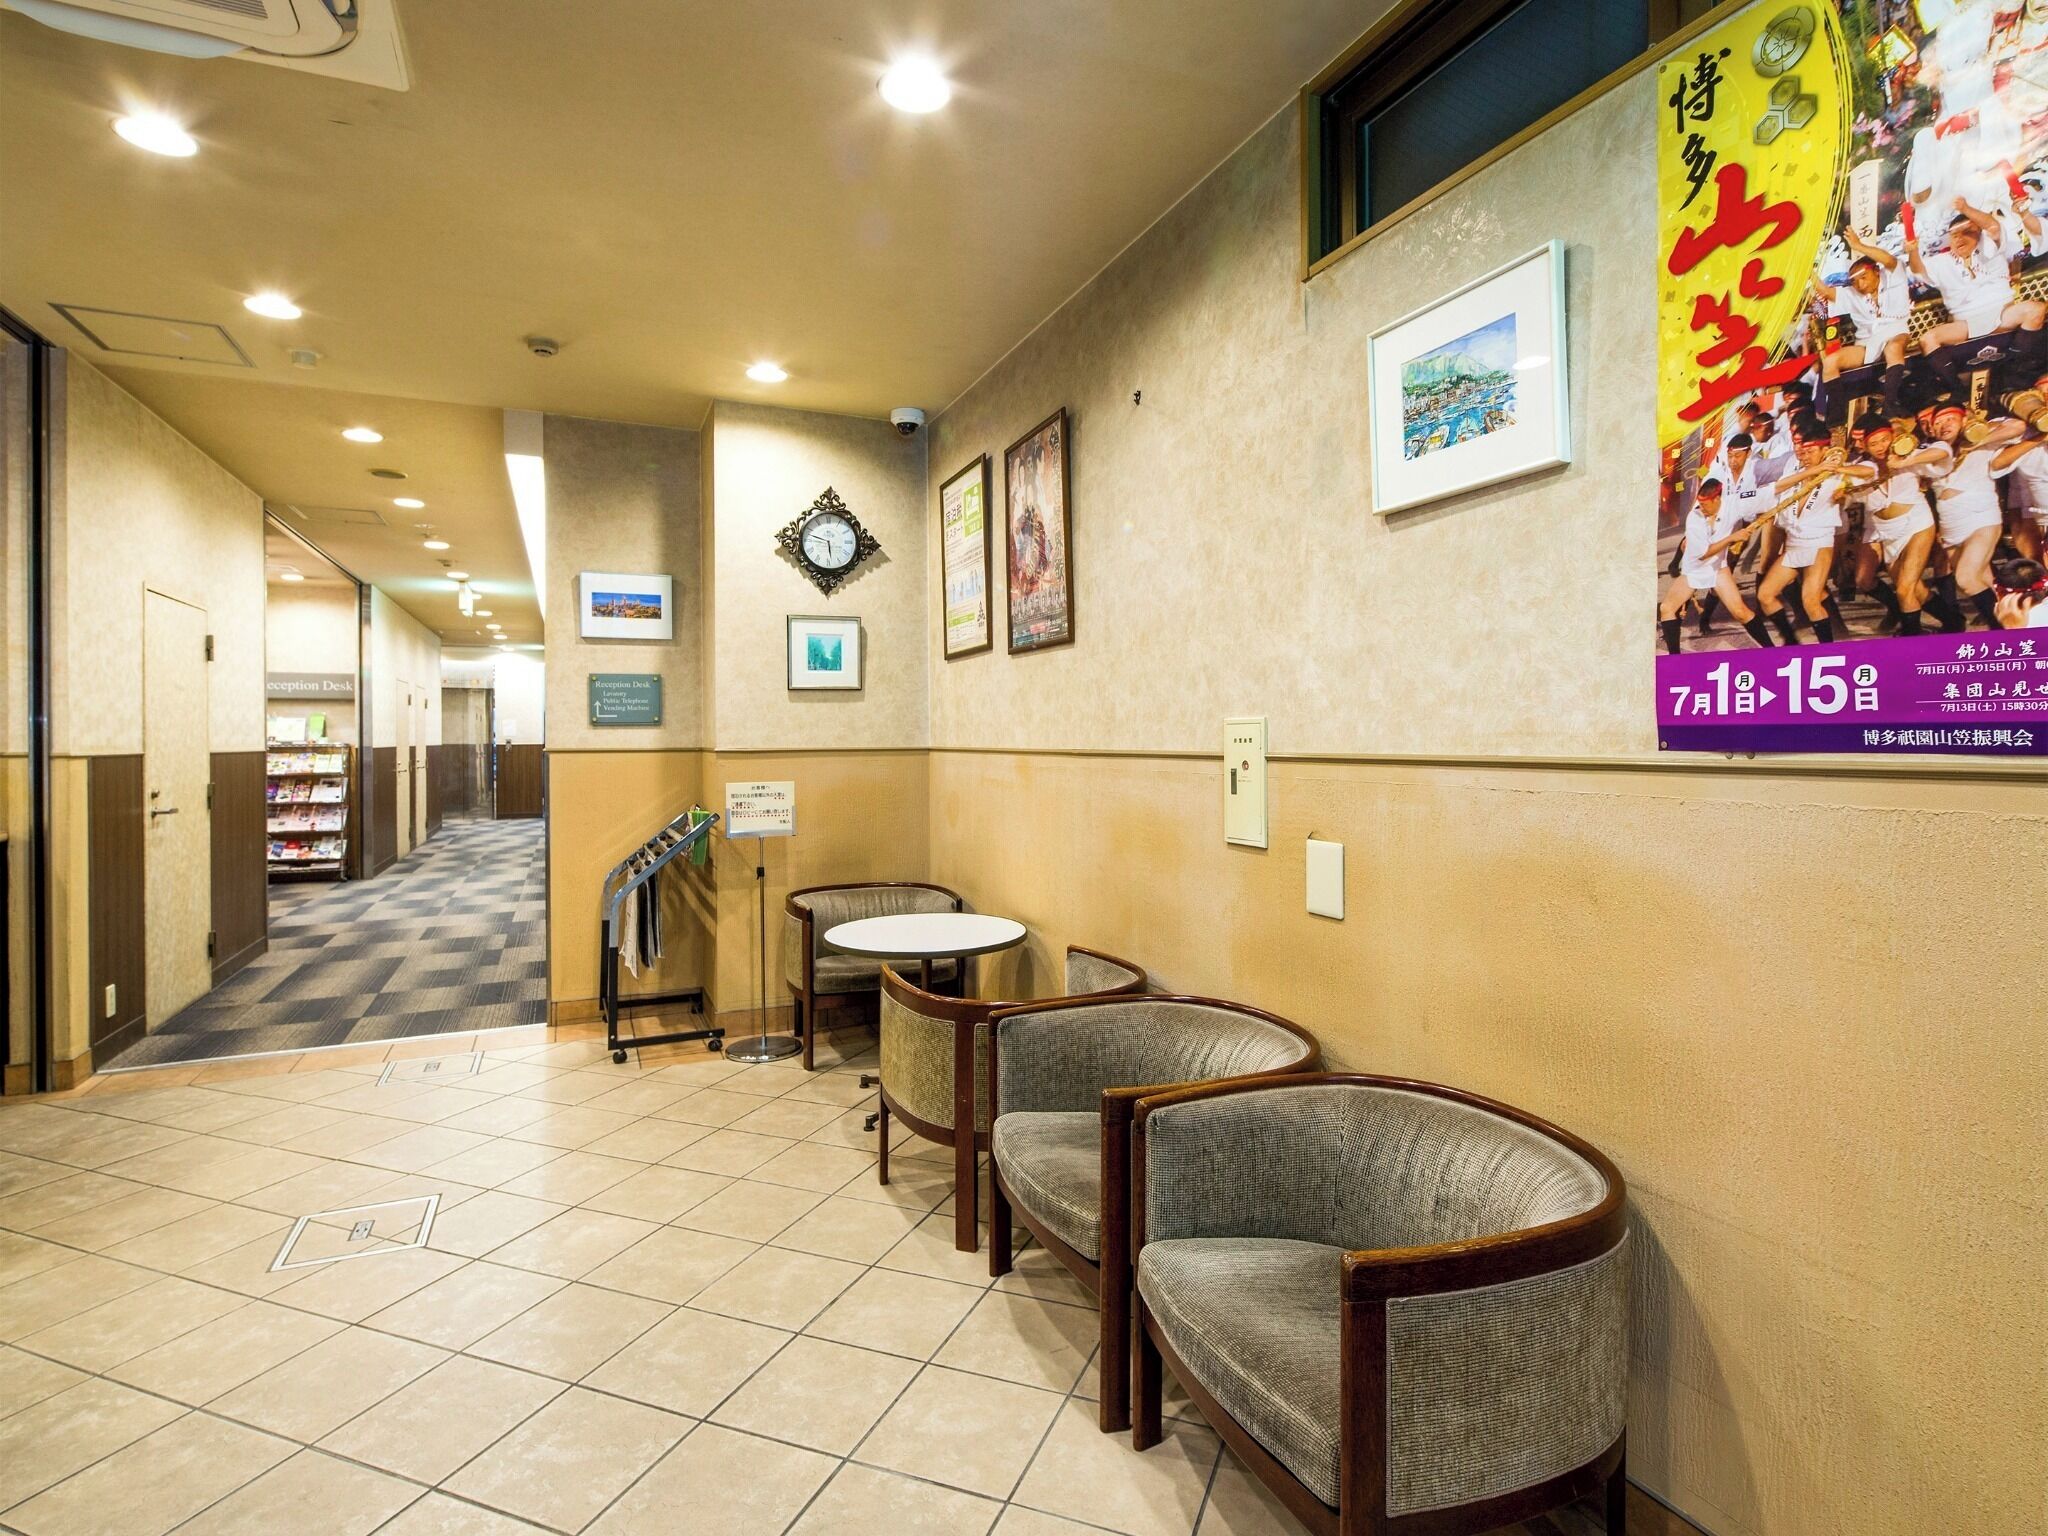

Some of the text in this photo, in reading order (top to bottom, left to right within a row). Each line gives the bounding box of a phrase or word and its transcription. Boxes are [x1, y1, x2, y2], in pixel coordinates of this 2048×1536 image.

[1667, 47, 1819, 422] 博多 山笠
[1956, 639, 2038, 660] 飾り山笠
[267, 680, 353, 693] eception Desk
[596, 681, 630, 689] Reception
